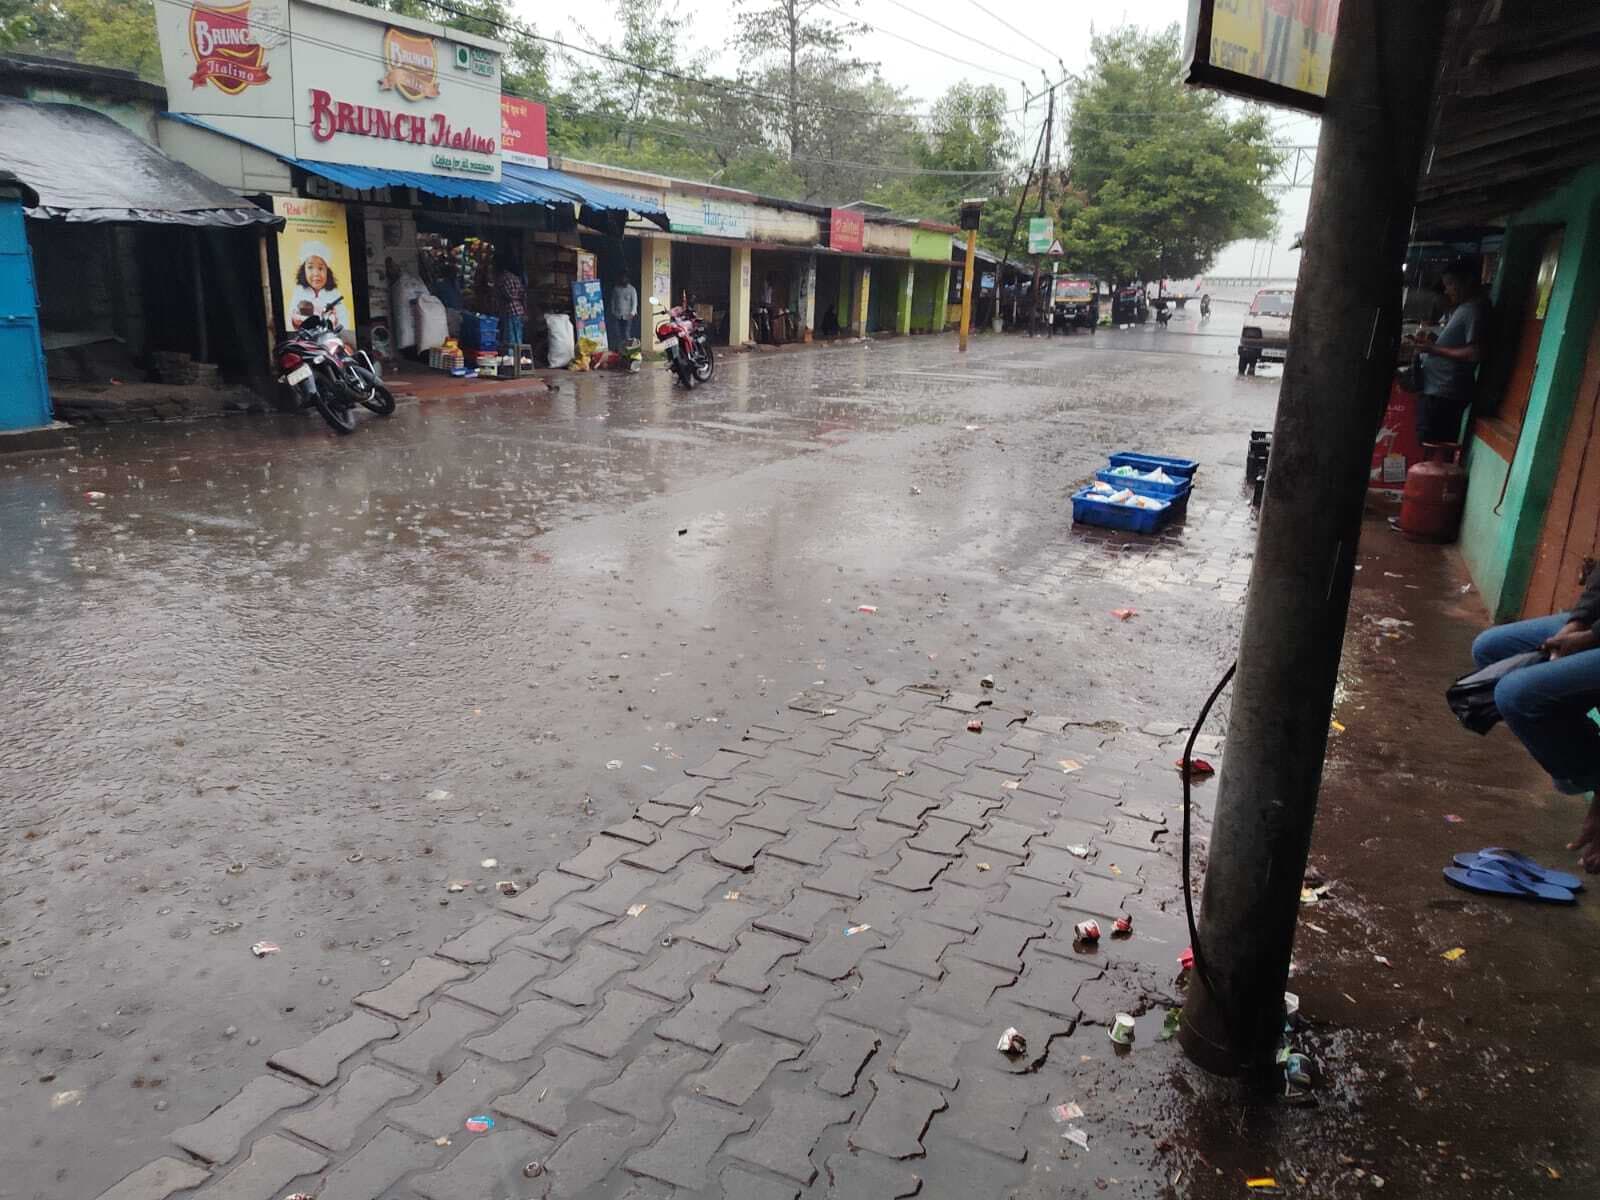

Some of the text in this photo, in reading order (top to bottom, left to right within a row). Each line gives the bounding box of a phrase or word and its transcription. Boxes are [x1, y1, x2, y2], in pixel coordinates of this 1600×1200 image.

[195, 21, 249, 56] BRUNC
[310, 88, 496, 155] BRUNCH Italino
[435, 154, 452, 167] Cakes
[453, 156, 461, 168] for
